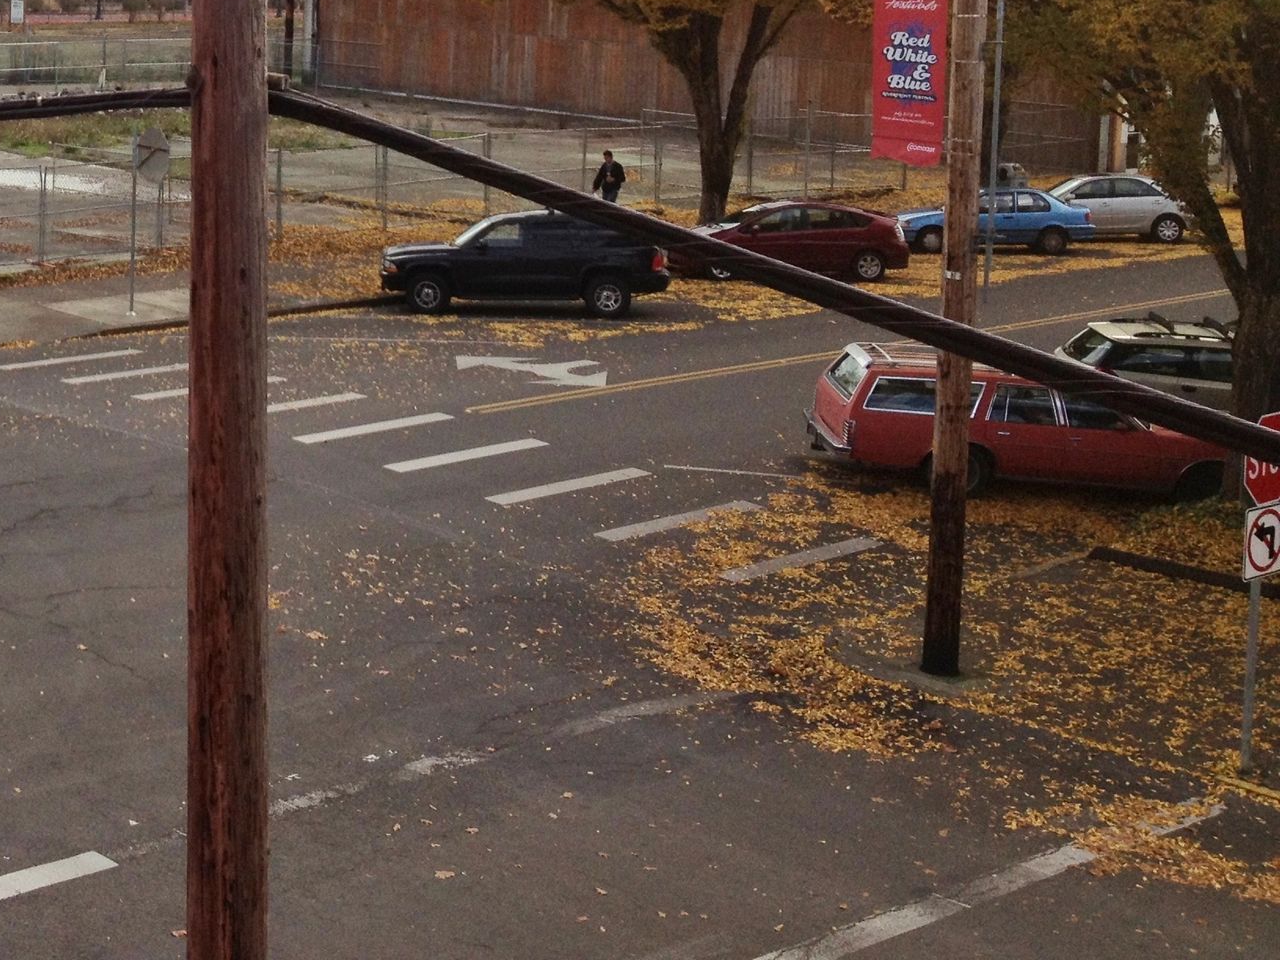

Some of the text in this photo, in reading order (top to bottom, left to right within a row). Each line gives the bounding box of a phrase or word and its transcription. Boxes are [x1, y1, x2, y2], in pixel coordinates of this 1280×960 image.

[891, 31, 930, 47] Red
[883, 46, 937, 64] White
[912, 64, 931, 80] &
[888, 74, 931, 91] Blue
